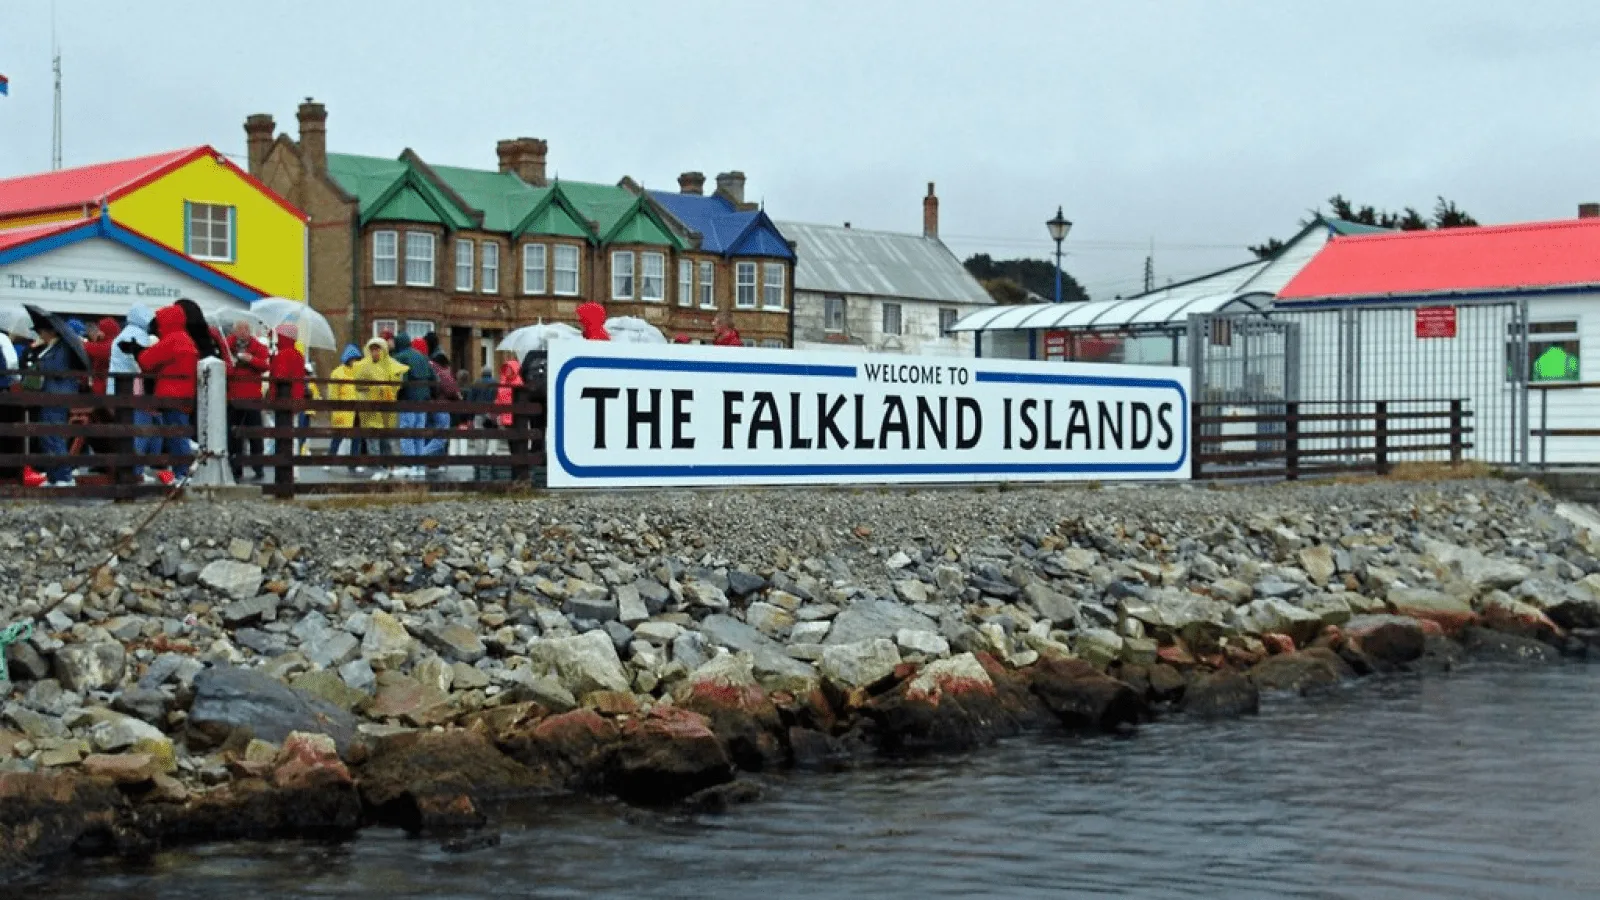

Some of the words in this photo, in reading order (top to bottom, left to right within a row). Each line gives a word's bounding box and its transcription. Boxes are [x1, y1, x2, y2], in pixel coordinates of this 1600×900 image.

[8, 274, 37, 290] The
[41, 276, 77, 293] Jetty
[84, 278, 130, 296] Visitor
[136, 282, 181, 298] Centre
[864, 363, 942, 384] WELCOME
[948, 366, 969, 385] TO
[580, 387, 696, 450] THE
[722, 390, 983, 451] FALKLAND
[1003, 397, 1174, 451] ISLANDS
